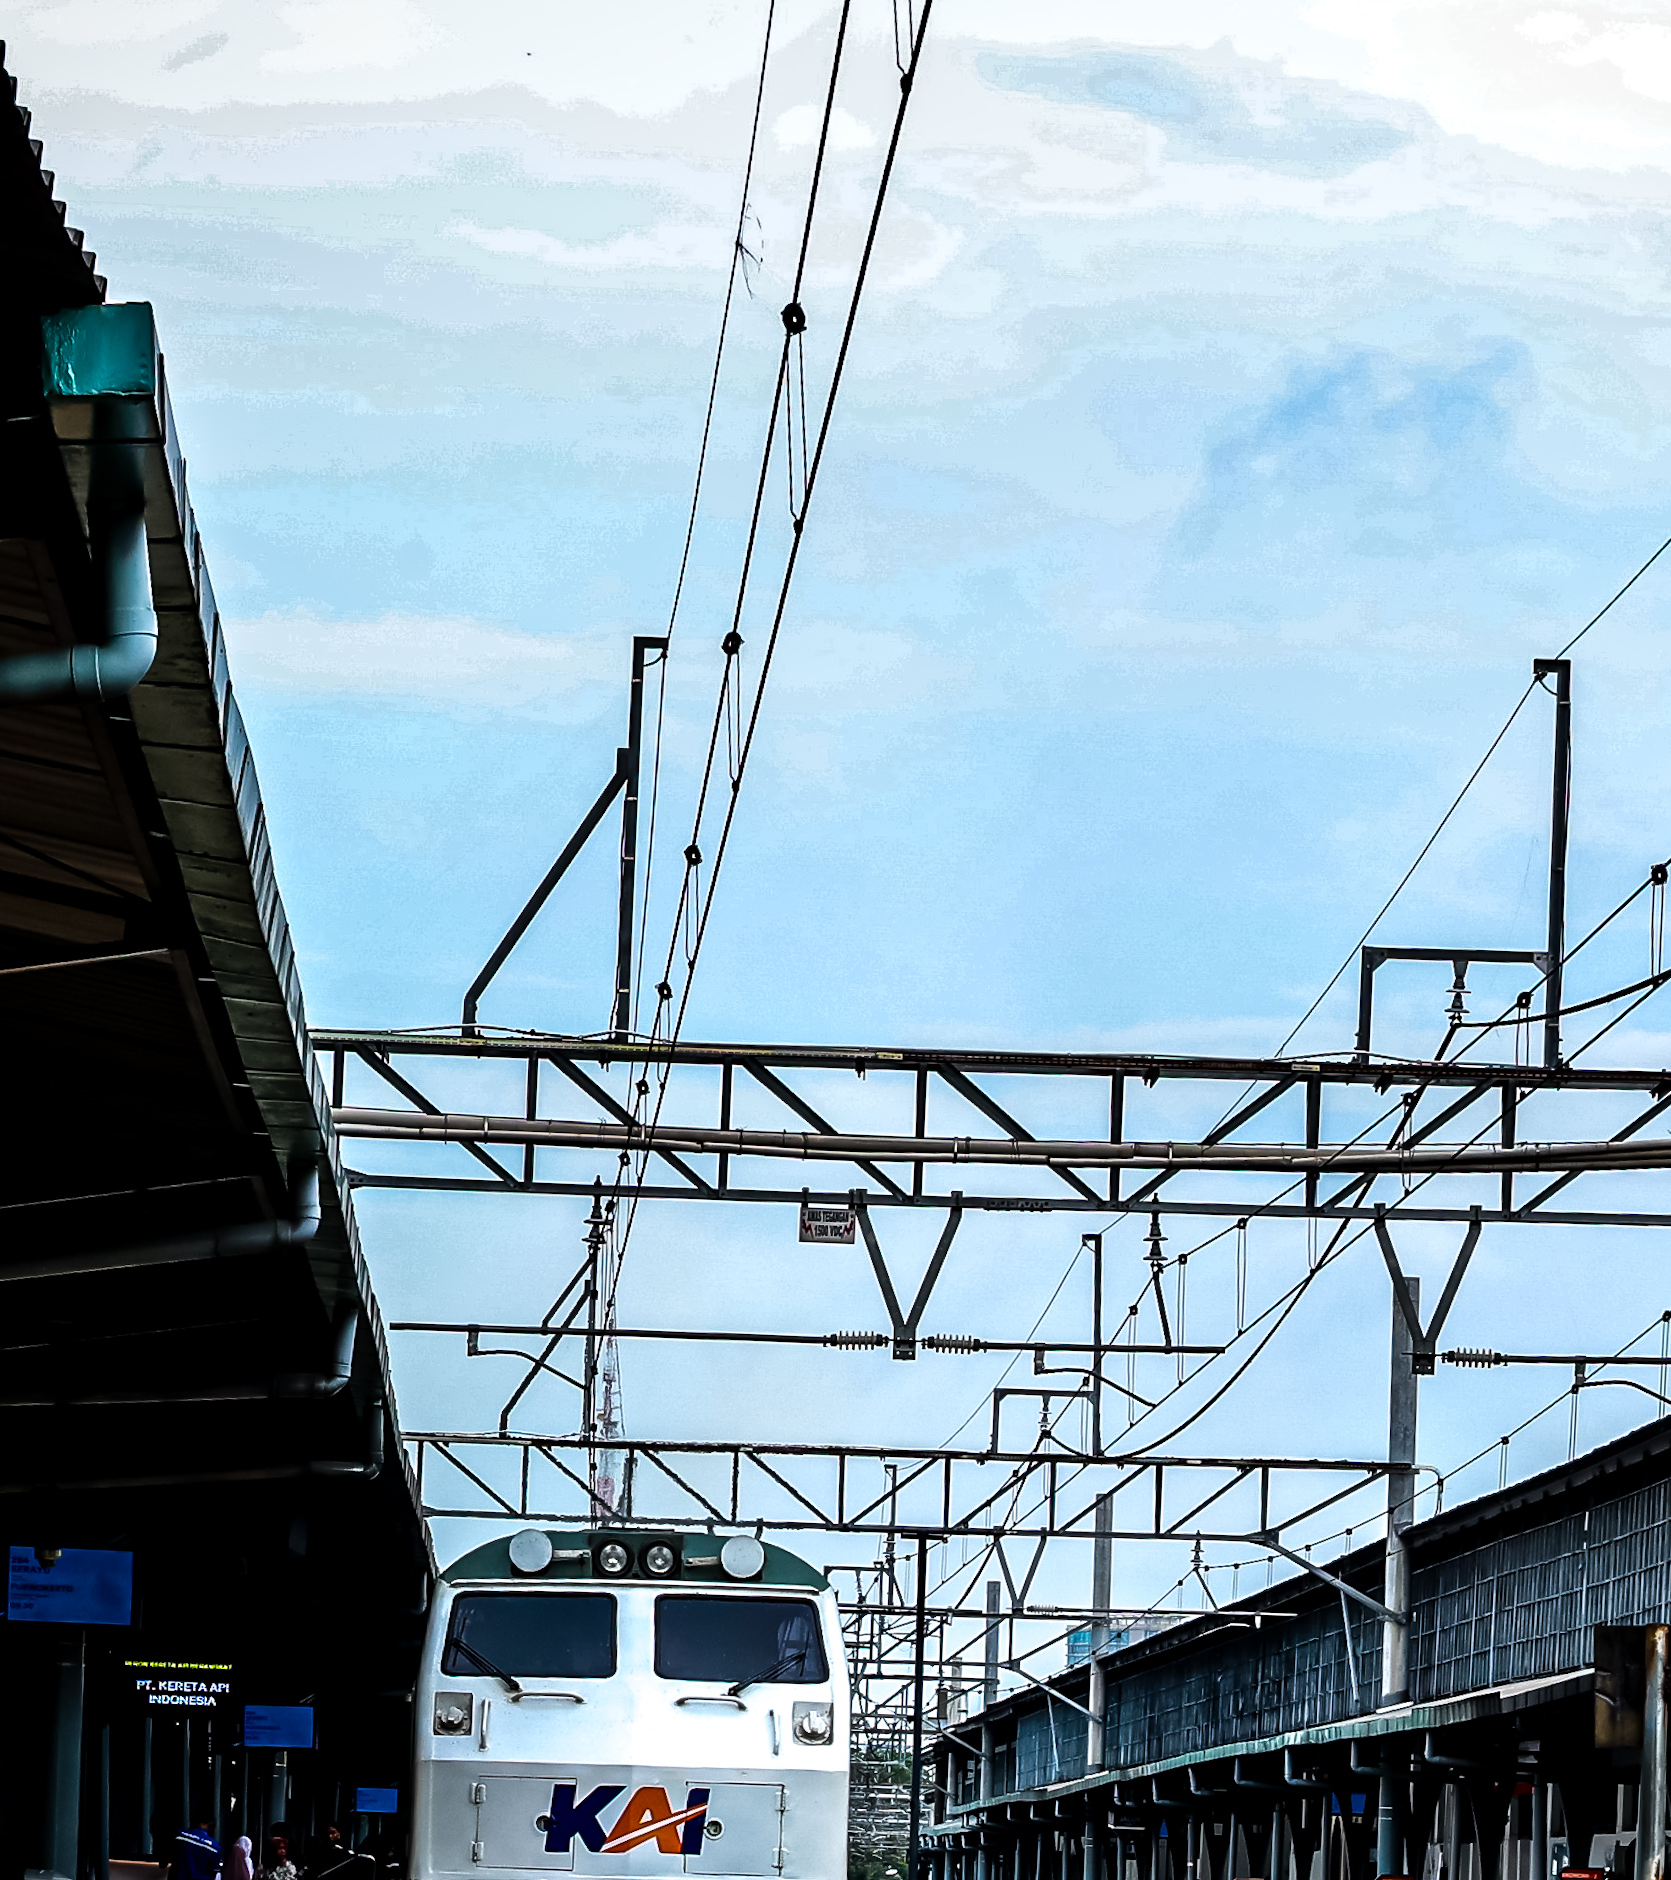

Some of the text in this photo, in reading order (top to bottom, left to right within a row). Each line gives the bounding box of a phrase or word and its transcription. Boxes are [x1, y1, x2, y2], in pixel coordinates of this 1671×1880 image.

[815, 1224, 828, 1237] 1500
[136, 1679, 231, 1694] PT. KERETA API
[148, 1694, 217, 1707] INDONESIA
[543, 1783, 711, 1855] KAI
